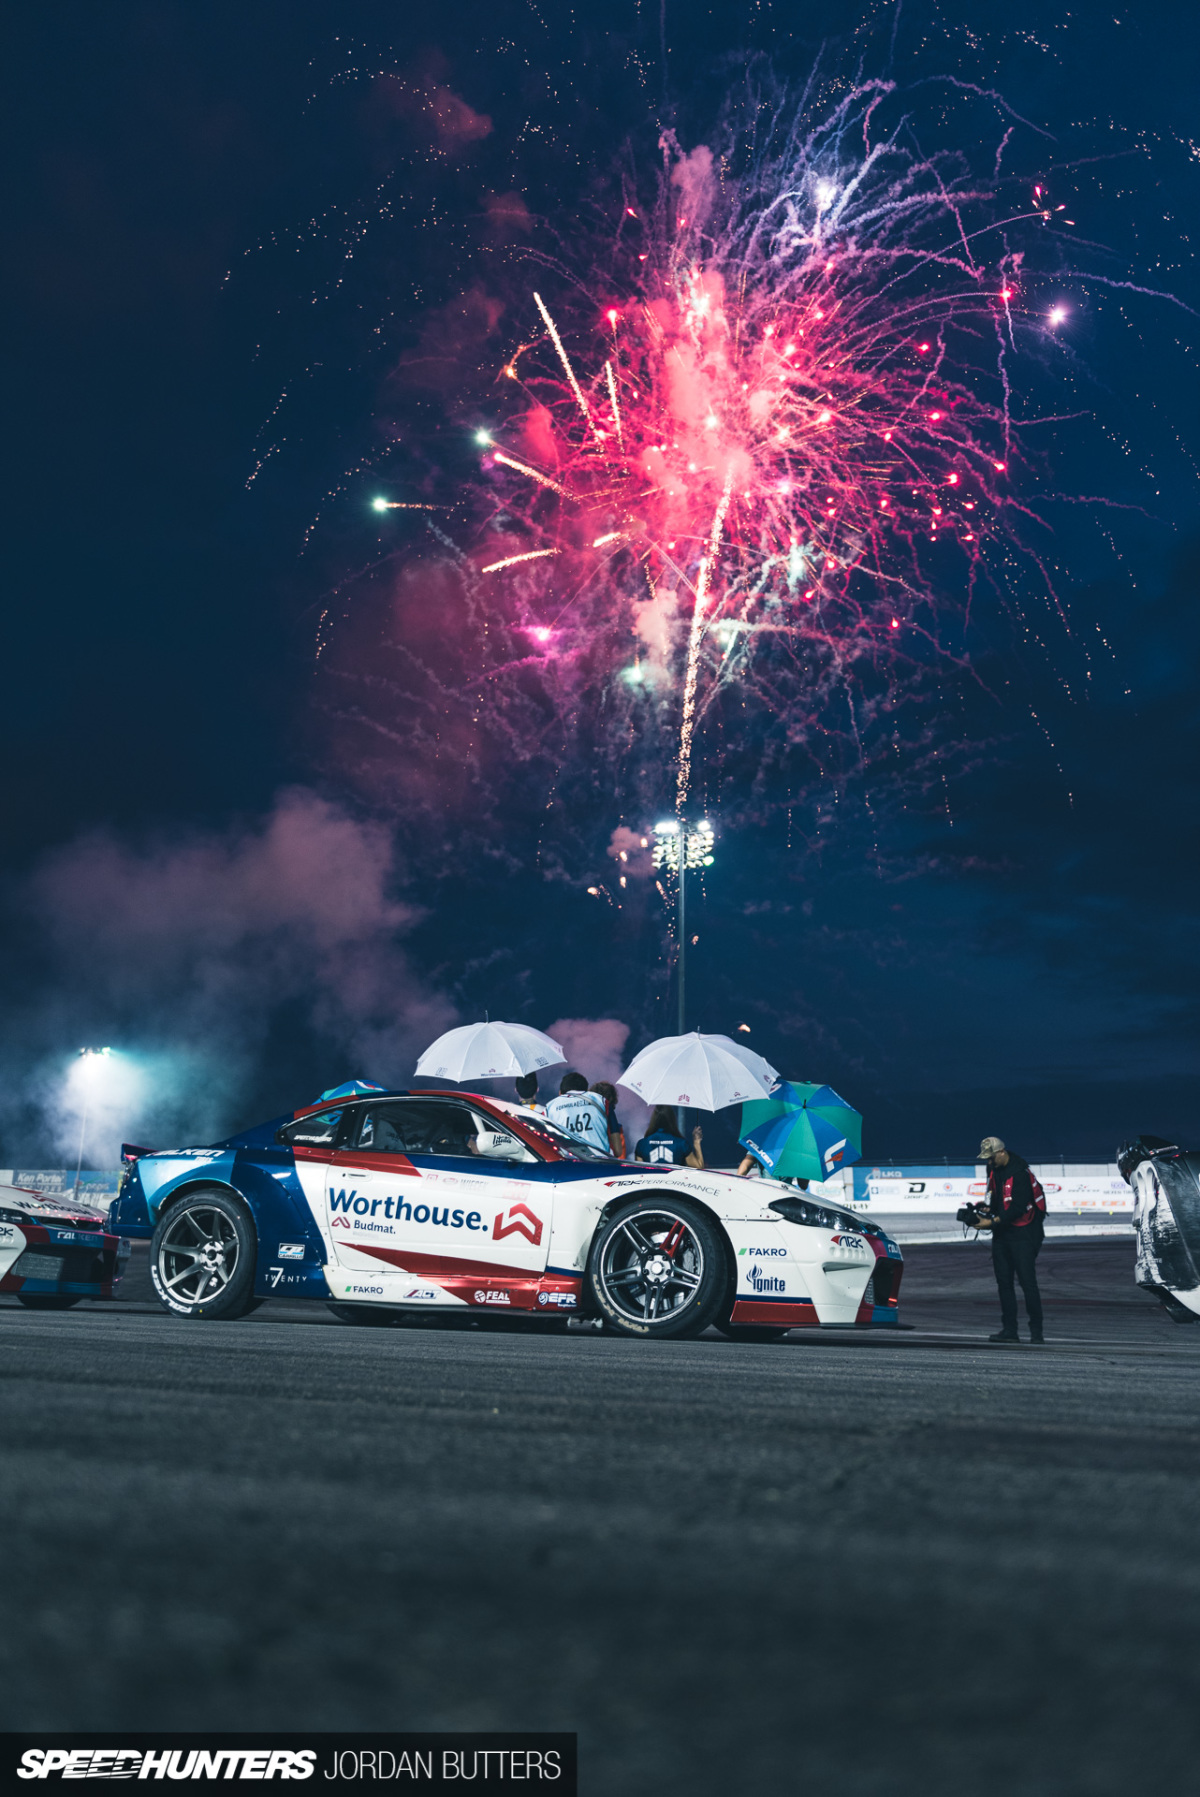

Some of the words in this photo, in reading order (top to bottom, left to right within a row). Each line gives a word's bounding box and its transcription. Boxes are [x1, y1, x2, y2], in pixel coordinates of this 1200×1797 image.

[566, 1113, 593, 1134] 462
[145, 1148, 226, 1158] FALKEN
[745, 1138, 775, 1168] FALKEN
[17, 1172, 35, 1183] Ken
[882, 1170, 903, 1178] LKQ
[640, 1179, 721, 1197] PERFORMANCE
[329, 1187, 489, 1232] Worthouse.
[353, 1219, 397, 1235] Budmat.
[57, 1231, 98, 1242] FALKEN
[831, 1234, 864, 1249] ARK
[749, 1247, 787, 1257] FAKRO
[151, 1264, 193, 1314] FALKEN
[353, 1285, 384, 1295] FAKRO
[753, 1276, 786, 1293] ignite
[486, 1291, 510, 1300] FEAL
[548, 1292, 577, 1304] EFR
